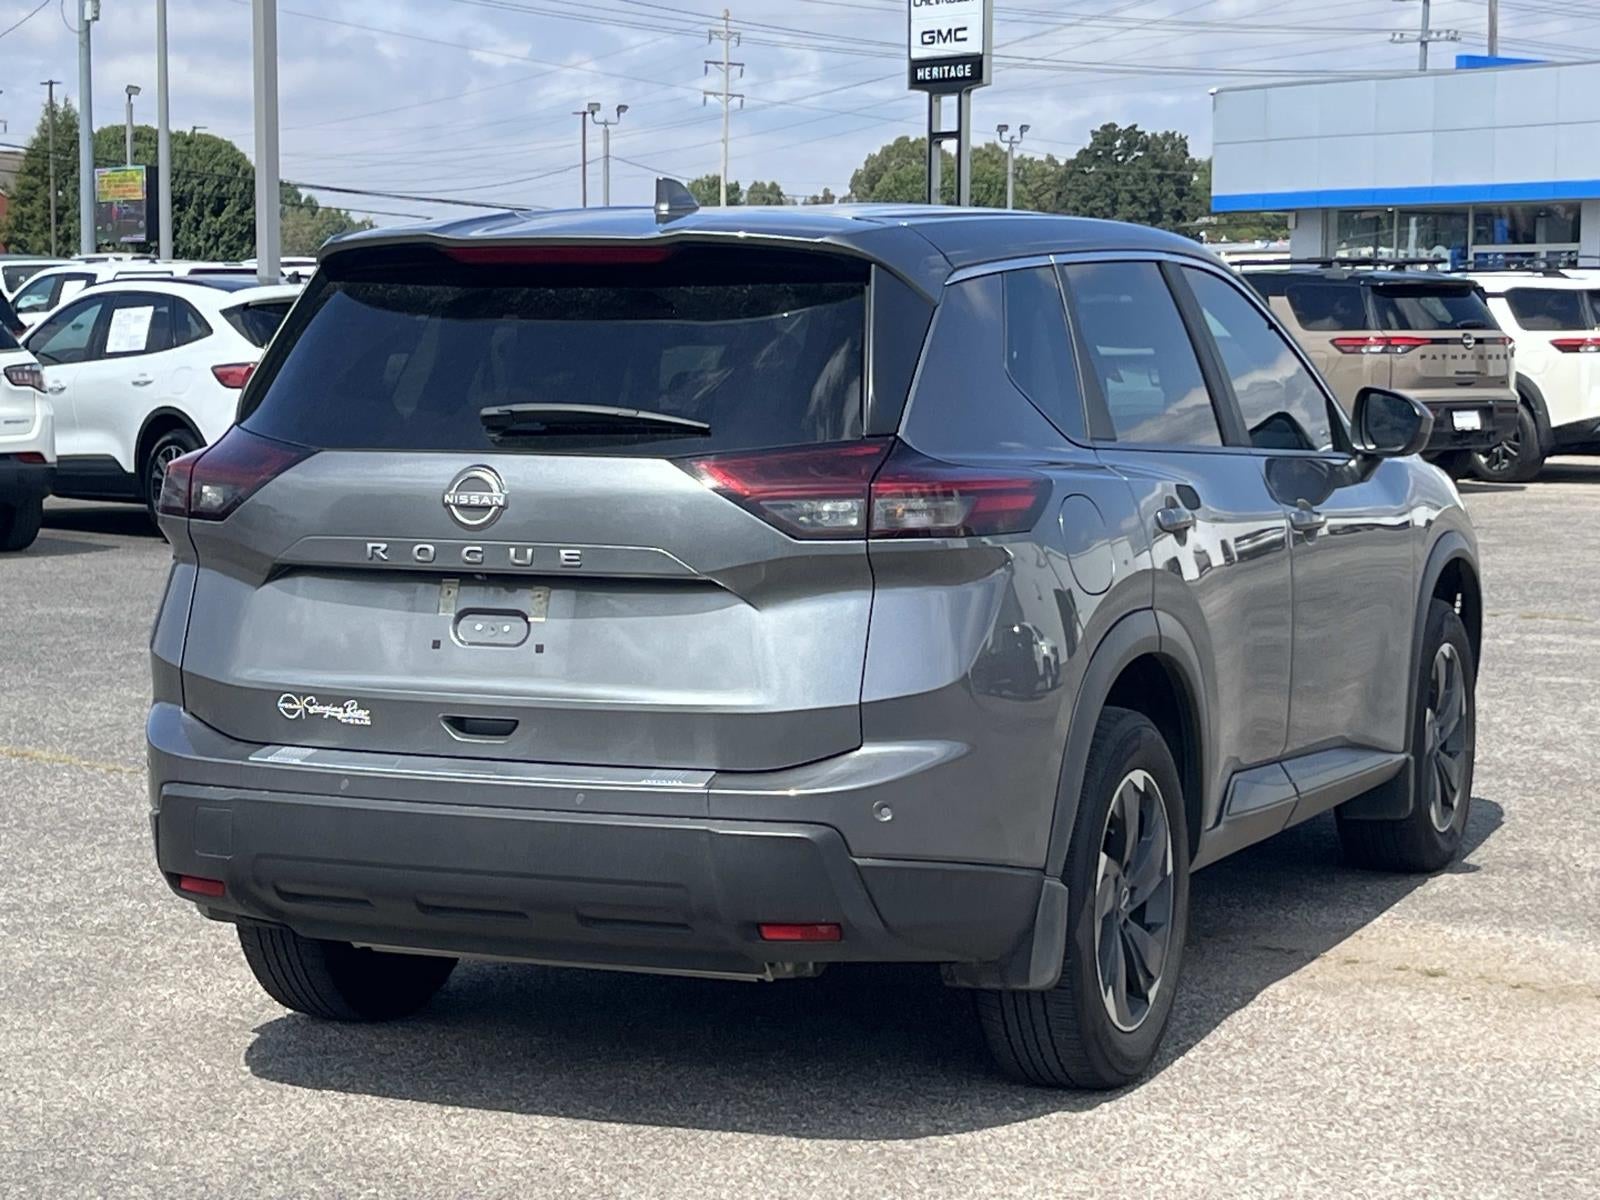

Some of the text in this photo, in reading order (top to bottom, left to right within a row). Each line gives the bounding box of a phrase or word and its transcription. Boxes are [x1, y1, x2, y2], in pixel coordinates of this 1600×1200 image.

[920, 26, 968, 45] GMC
[916, 64, 972, 80] HERITAGE
[444, 493, 504, 506] NISSAN
[366, 542, 582, 567] ROGUE
